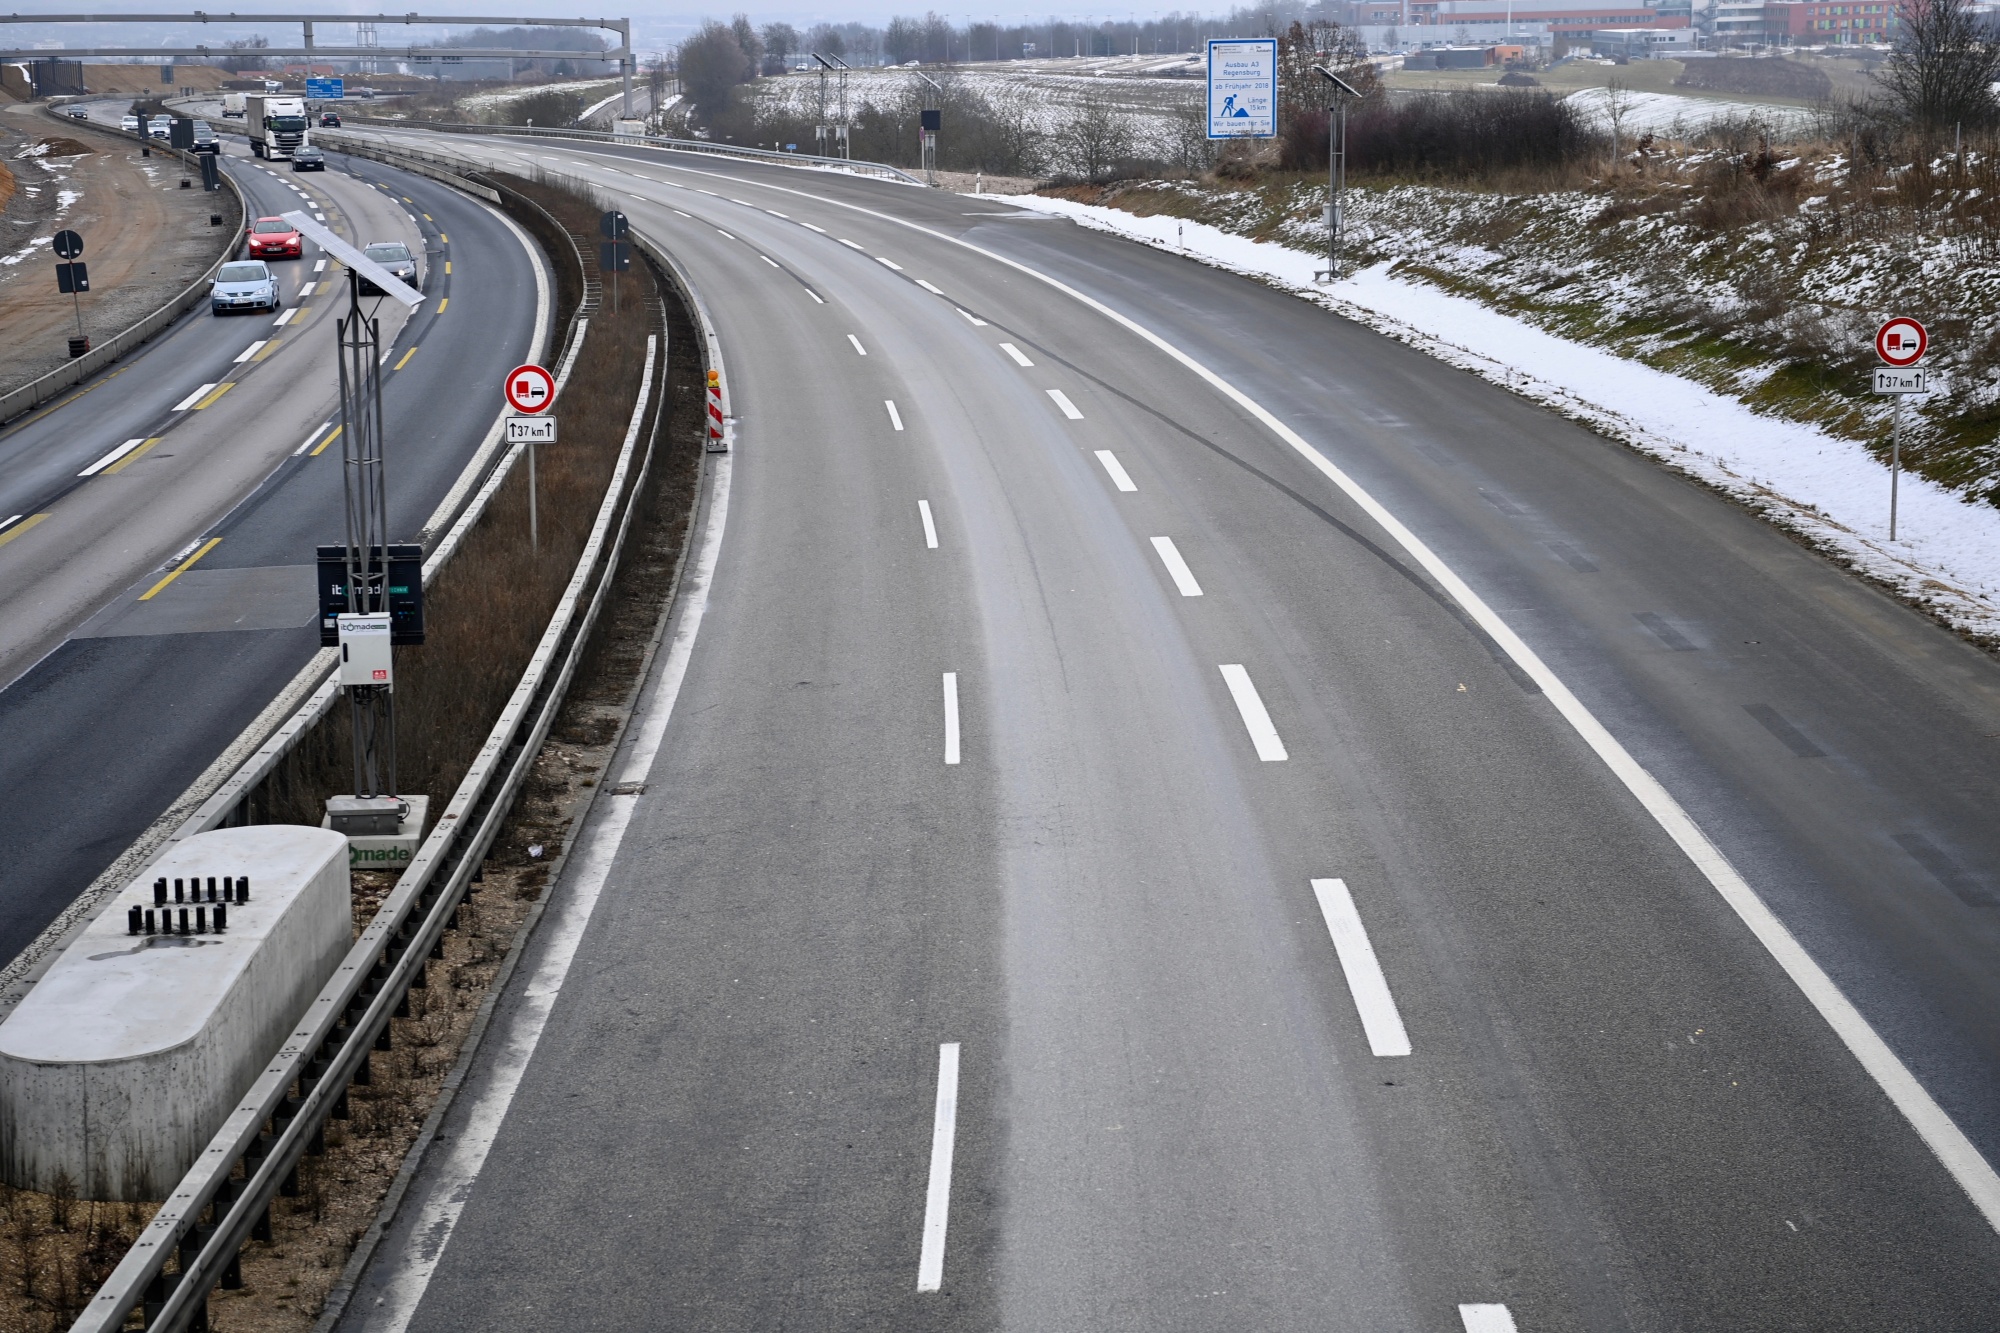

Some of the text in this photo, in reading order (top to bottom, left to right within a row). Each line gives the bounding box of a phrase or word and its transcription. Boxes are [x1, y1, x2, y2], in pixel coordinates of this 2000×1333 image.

[1886, 376, 1913, 387] 37 km
[518, 426, 544, 437] 37 km
